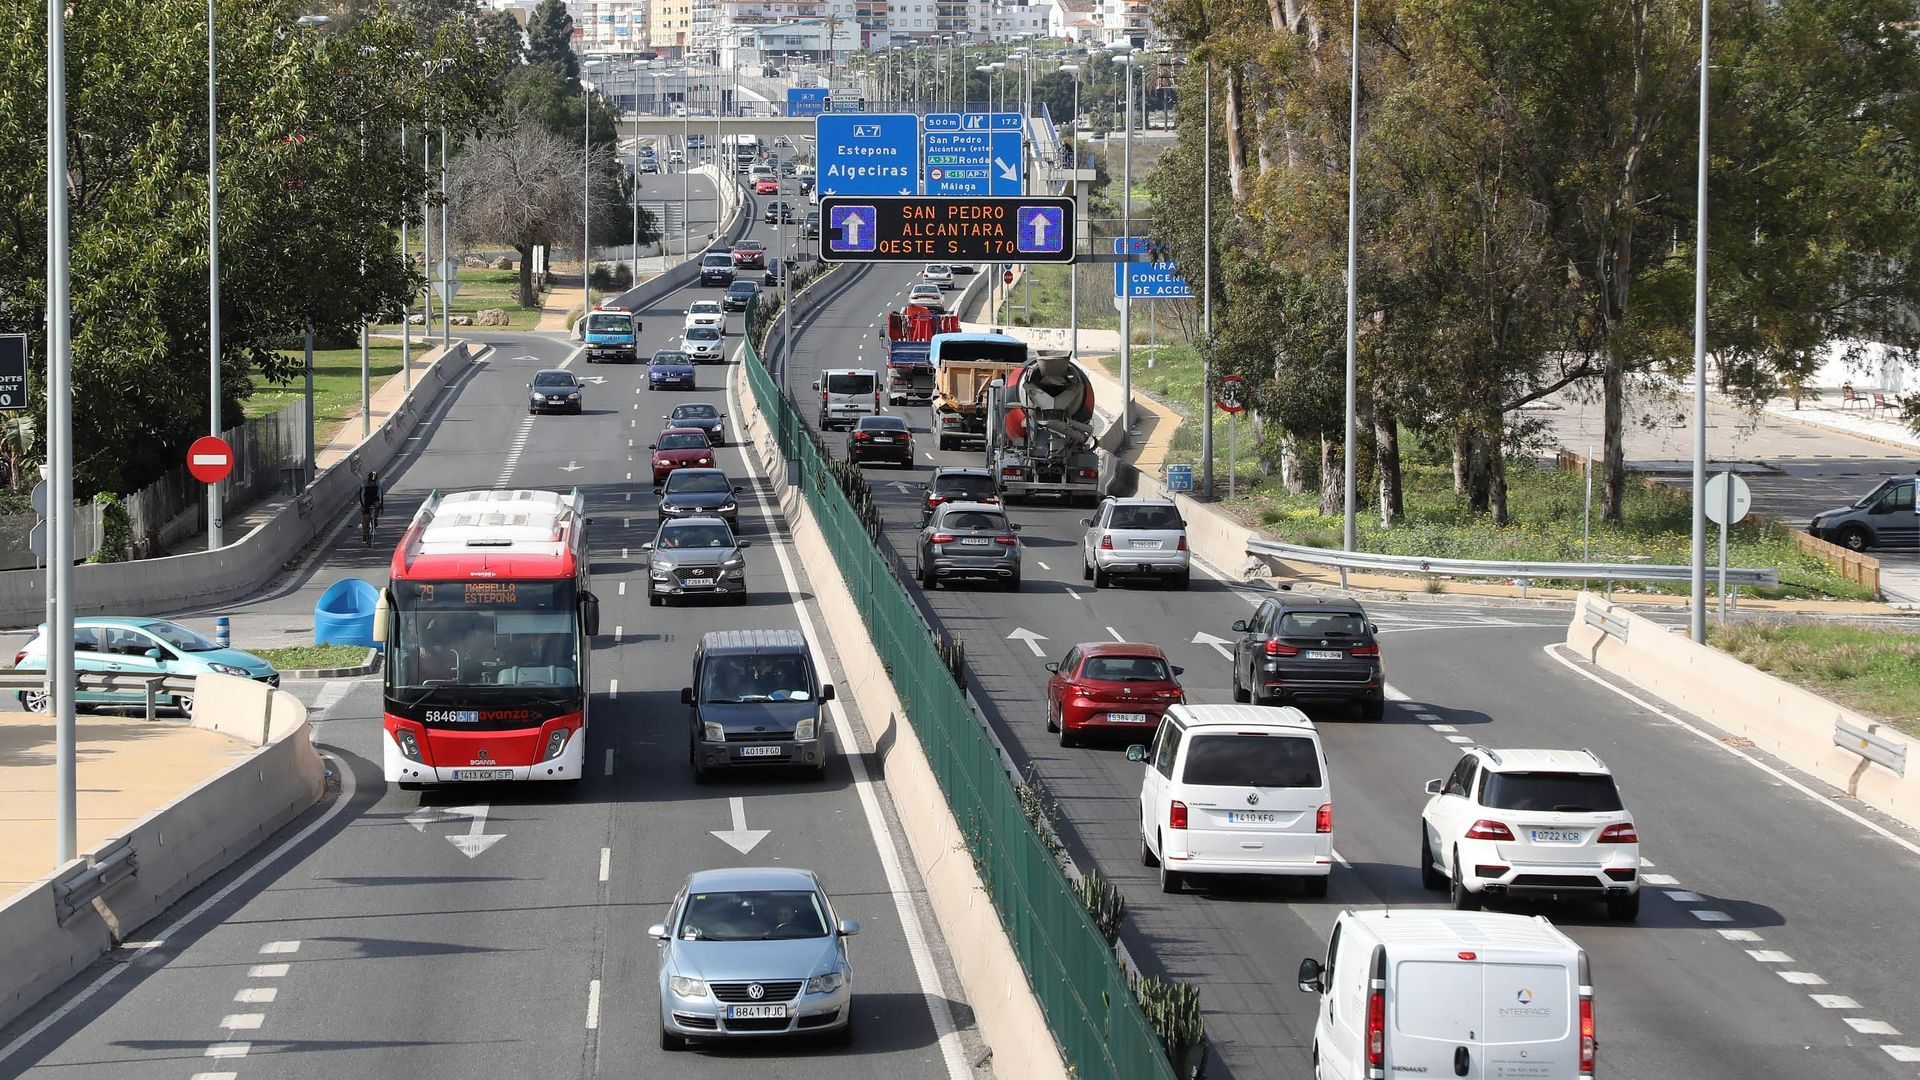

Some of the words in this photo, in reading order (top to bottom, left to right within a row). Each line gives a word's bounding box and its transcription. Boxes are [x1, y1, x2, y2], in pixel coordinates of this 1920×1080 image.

[855, 126, 880, 136] A-7
[929, 136, 948, 144] San
[953, 136, 982, 144] Pedro
[838, 145, 897, 157] Estepona
[929, 156, 956, 164] A-397
[959, 156, 990, 164] Ronda
[827, 164, 908, 180] Algeciras
[946, 170, 964, 178] E-15
[967, 170, 987, 178] AP-7
[941, 182, 976, 192] Málaga
[902, 206, 936, 219] SAN
[948, 206, 1004, 219] PEDRO
[902, 223, 1004, 236] ALCANTARA
[879, 240, 935, 254] OESTE
[948, 240, 967, 254] S.
[983, 240, 1015, 254] 170
[1151, 262, 1177, 270] TRA
[1132, 274, 1186, 283] CONCEN
[1135, 286, 1150, 295] DE
[1171, 481, 1188, 489] 173
[418, 584, 435, 602] 79
[464, 583, 517, 592] MARBELLA
[464, 593, 517, 603] ESTEPONA
[425, 710, 457, 723] 5846
[479, 709, 529, 722] avanza
[745, 747, 764, 756] 4019
[460, 771, 477, 780] 1413
[480, 771, 493, 780] KCK
[1235, 813, 1256, 822] 1410
[1258, 813, 1275, 822] KFG
[1538, 832, 1560, 841] 0722
[1563, 832, 1579, 841] KCR
[735, 1007, 760, 1017] 8841
[764, 1006, 783, 1016] DJC
[1499, 1007, 1552, 1015] INTERFACE
[1391, 1065, 1428, 1073] RENAULT
